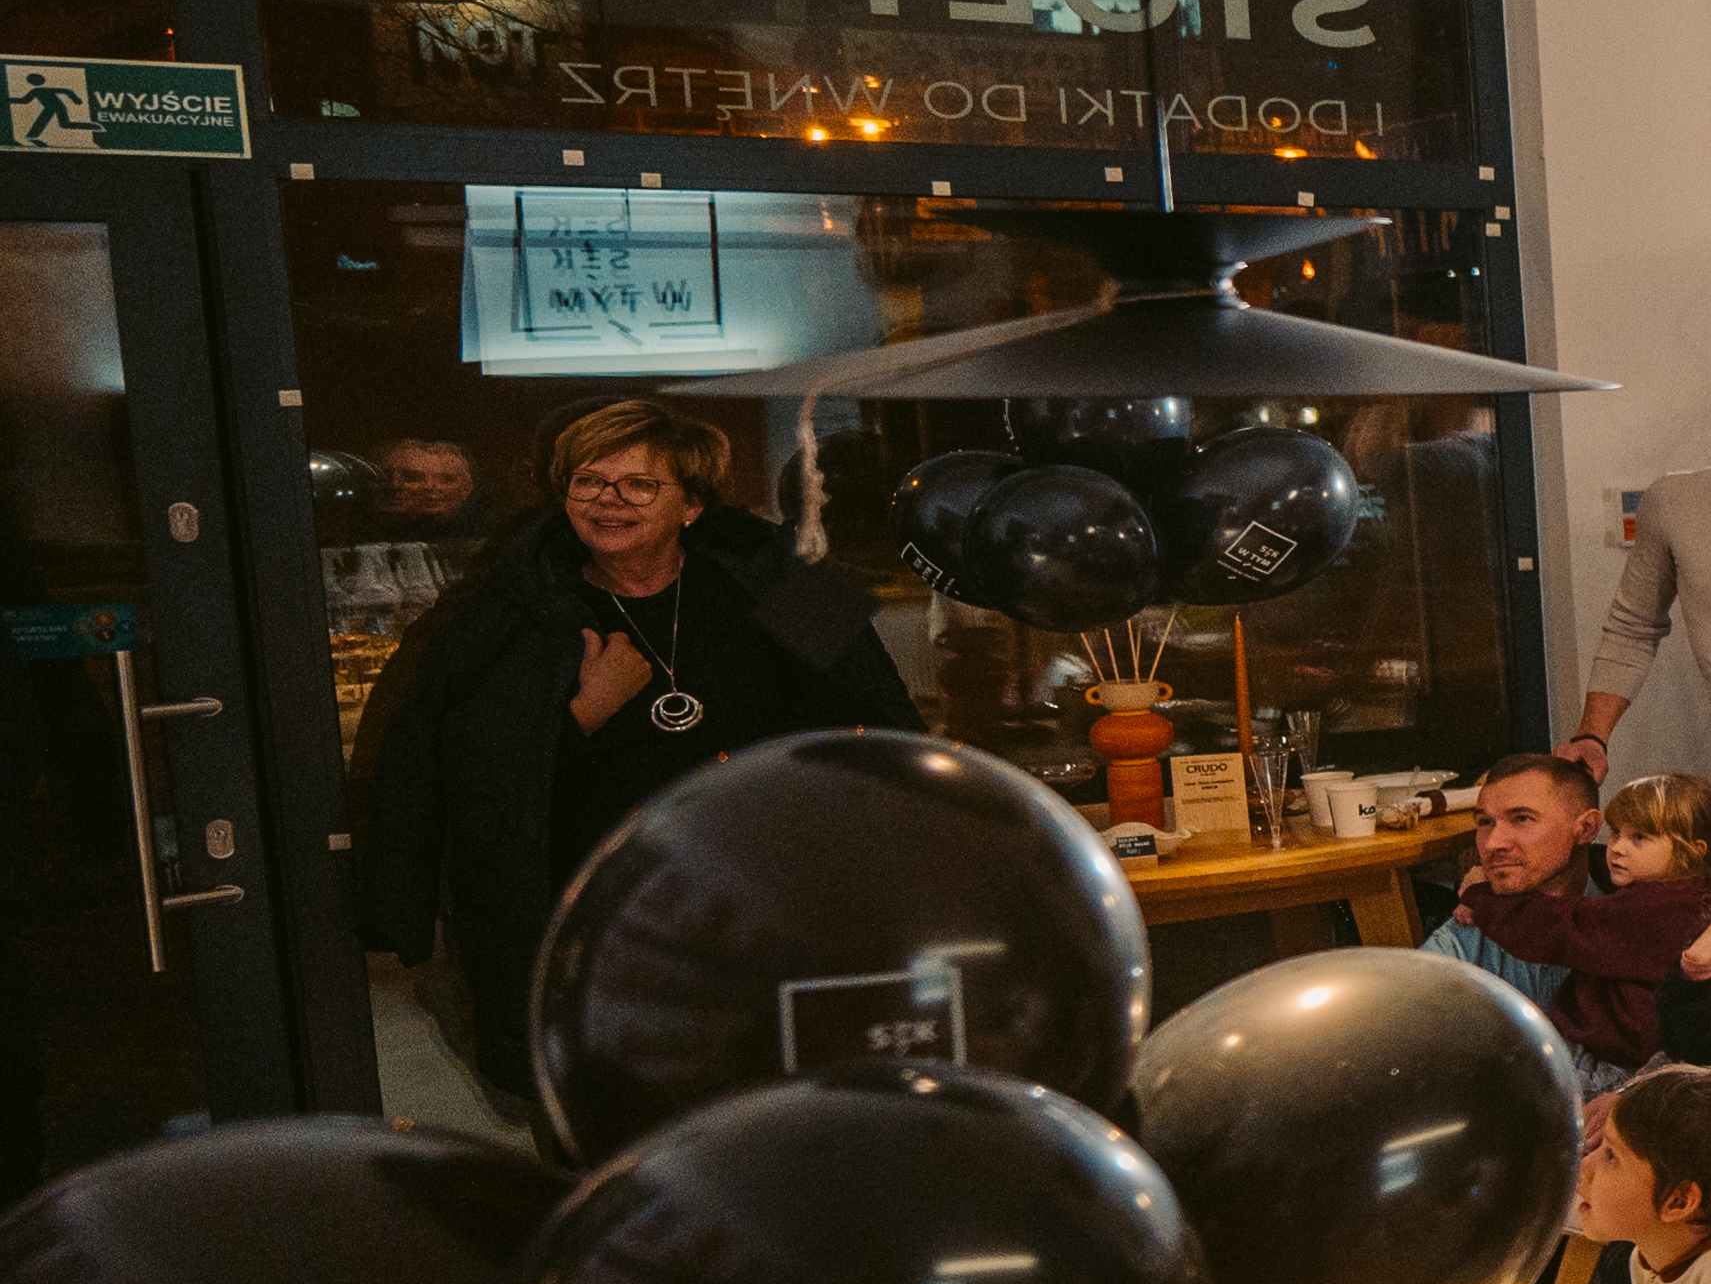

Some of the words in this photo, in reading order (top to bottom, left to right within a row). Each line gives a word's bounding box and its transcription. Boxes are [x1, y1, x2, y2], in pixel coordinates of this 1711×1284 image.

[94, 90, 233, 114] WYJŚCIE
[98, 111, 235, 128] EWAKUACYJNE
[1186, 763, 1228, 774] CRUDO
